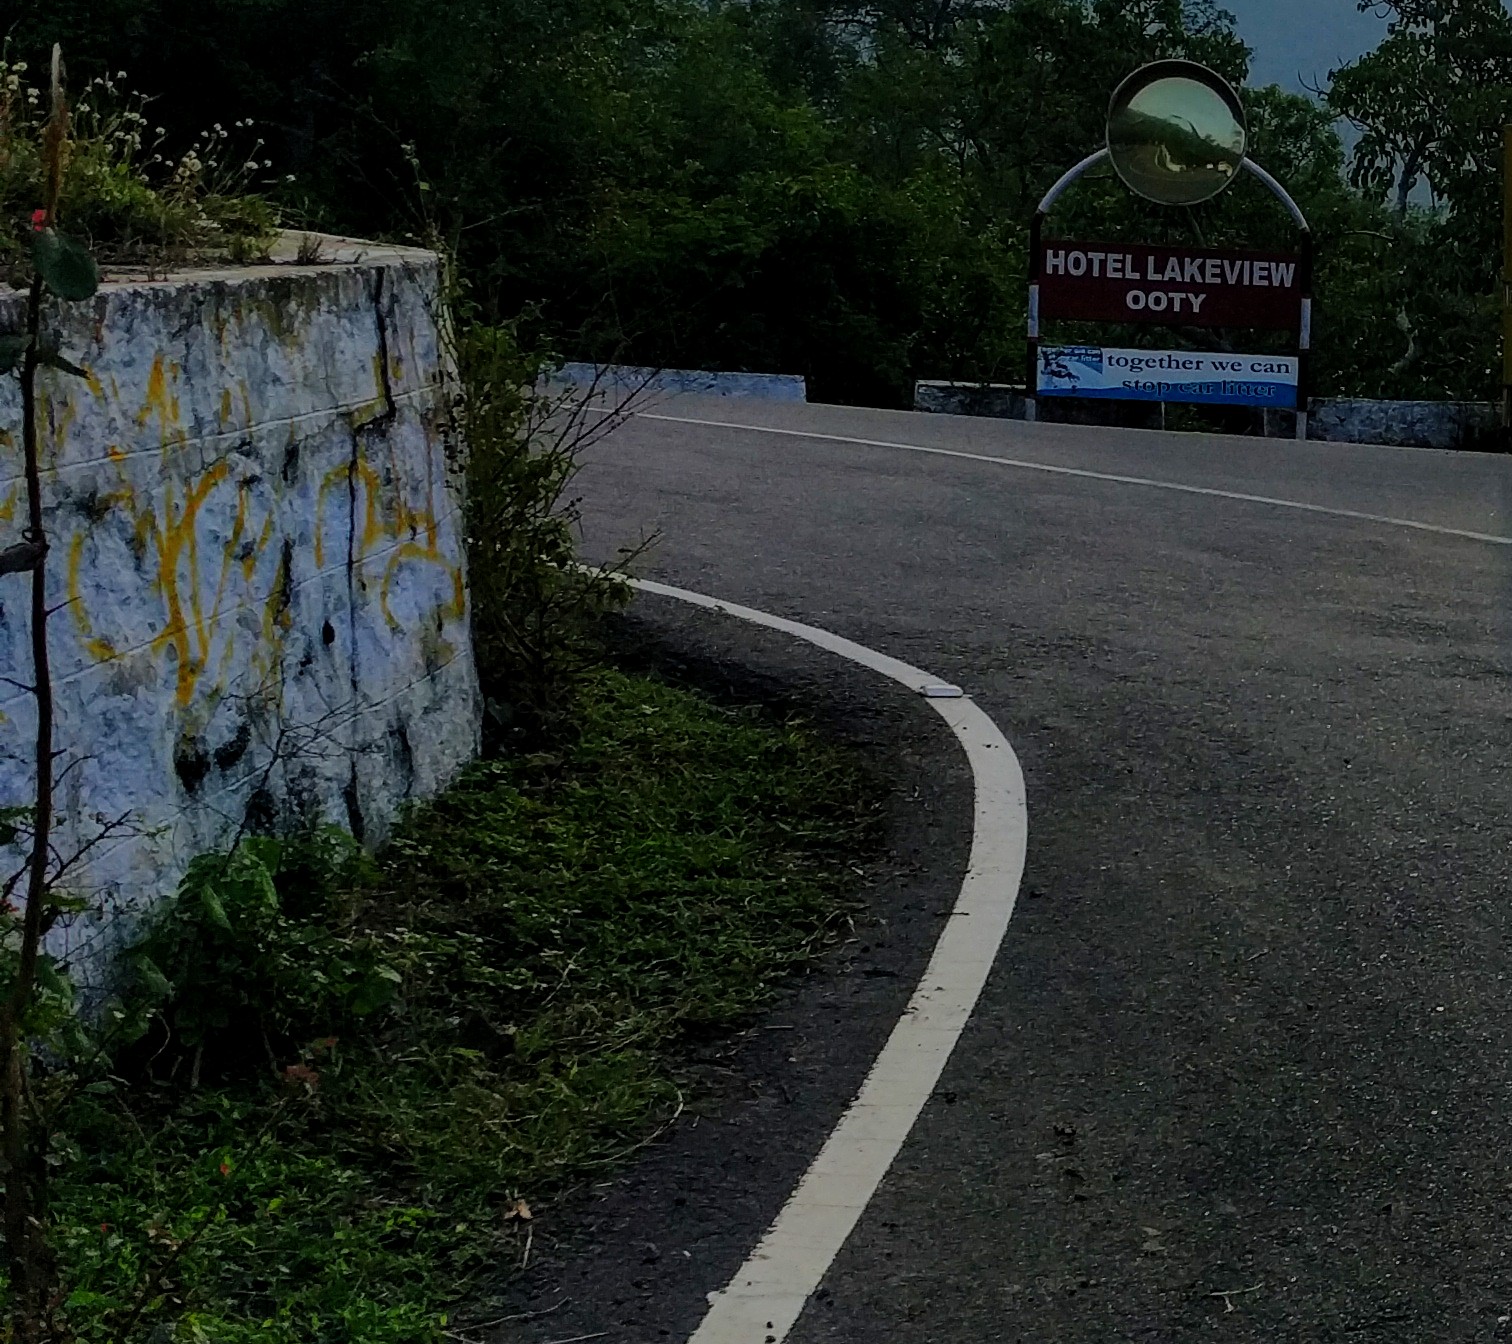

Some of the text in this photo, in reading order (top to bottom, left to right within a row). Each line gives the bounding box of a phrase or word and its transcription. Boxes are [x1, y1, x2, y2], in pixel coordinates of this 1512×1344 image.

[1046, 249, 1296, 288] HOTEL LAKEVIEW
[1126, 290, 1206, 313] OOTY
[1108, 354, 1204, 372] together
[1211, 360, 1242, 372] we
[1250, 359, 1290, 374] can
[1122, 379, 1276, 398] stop car litter
